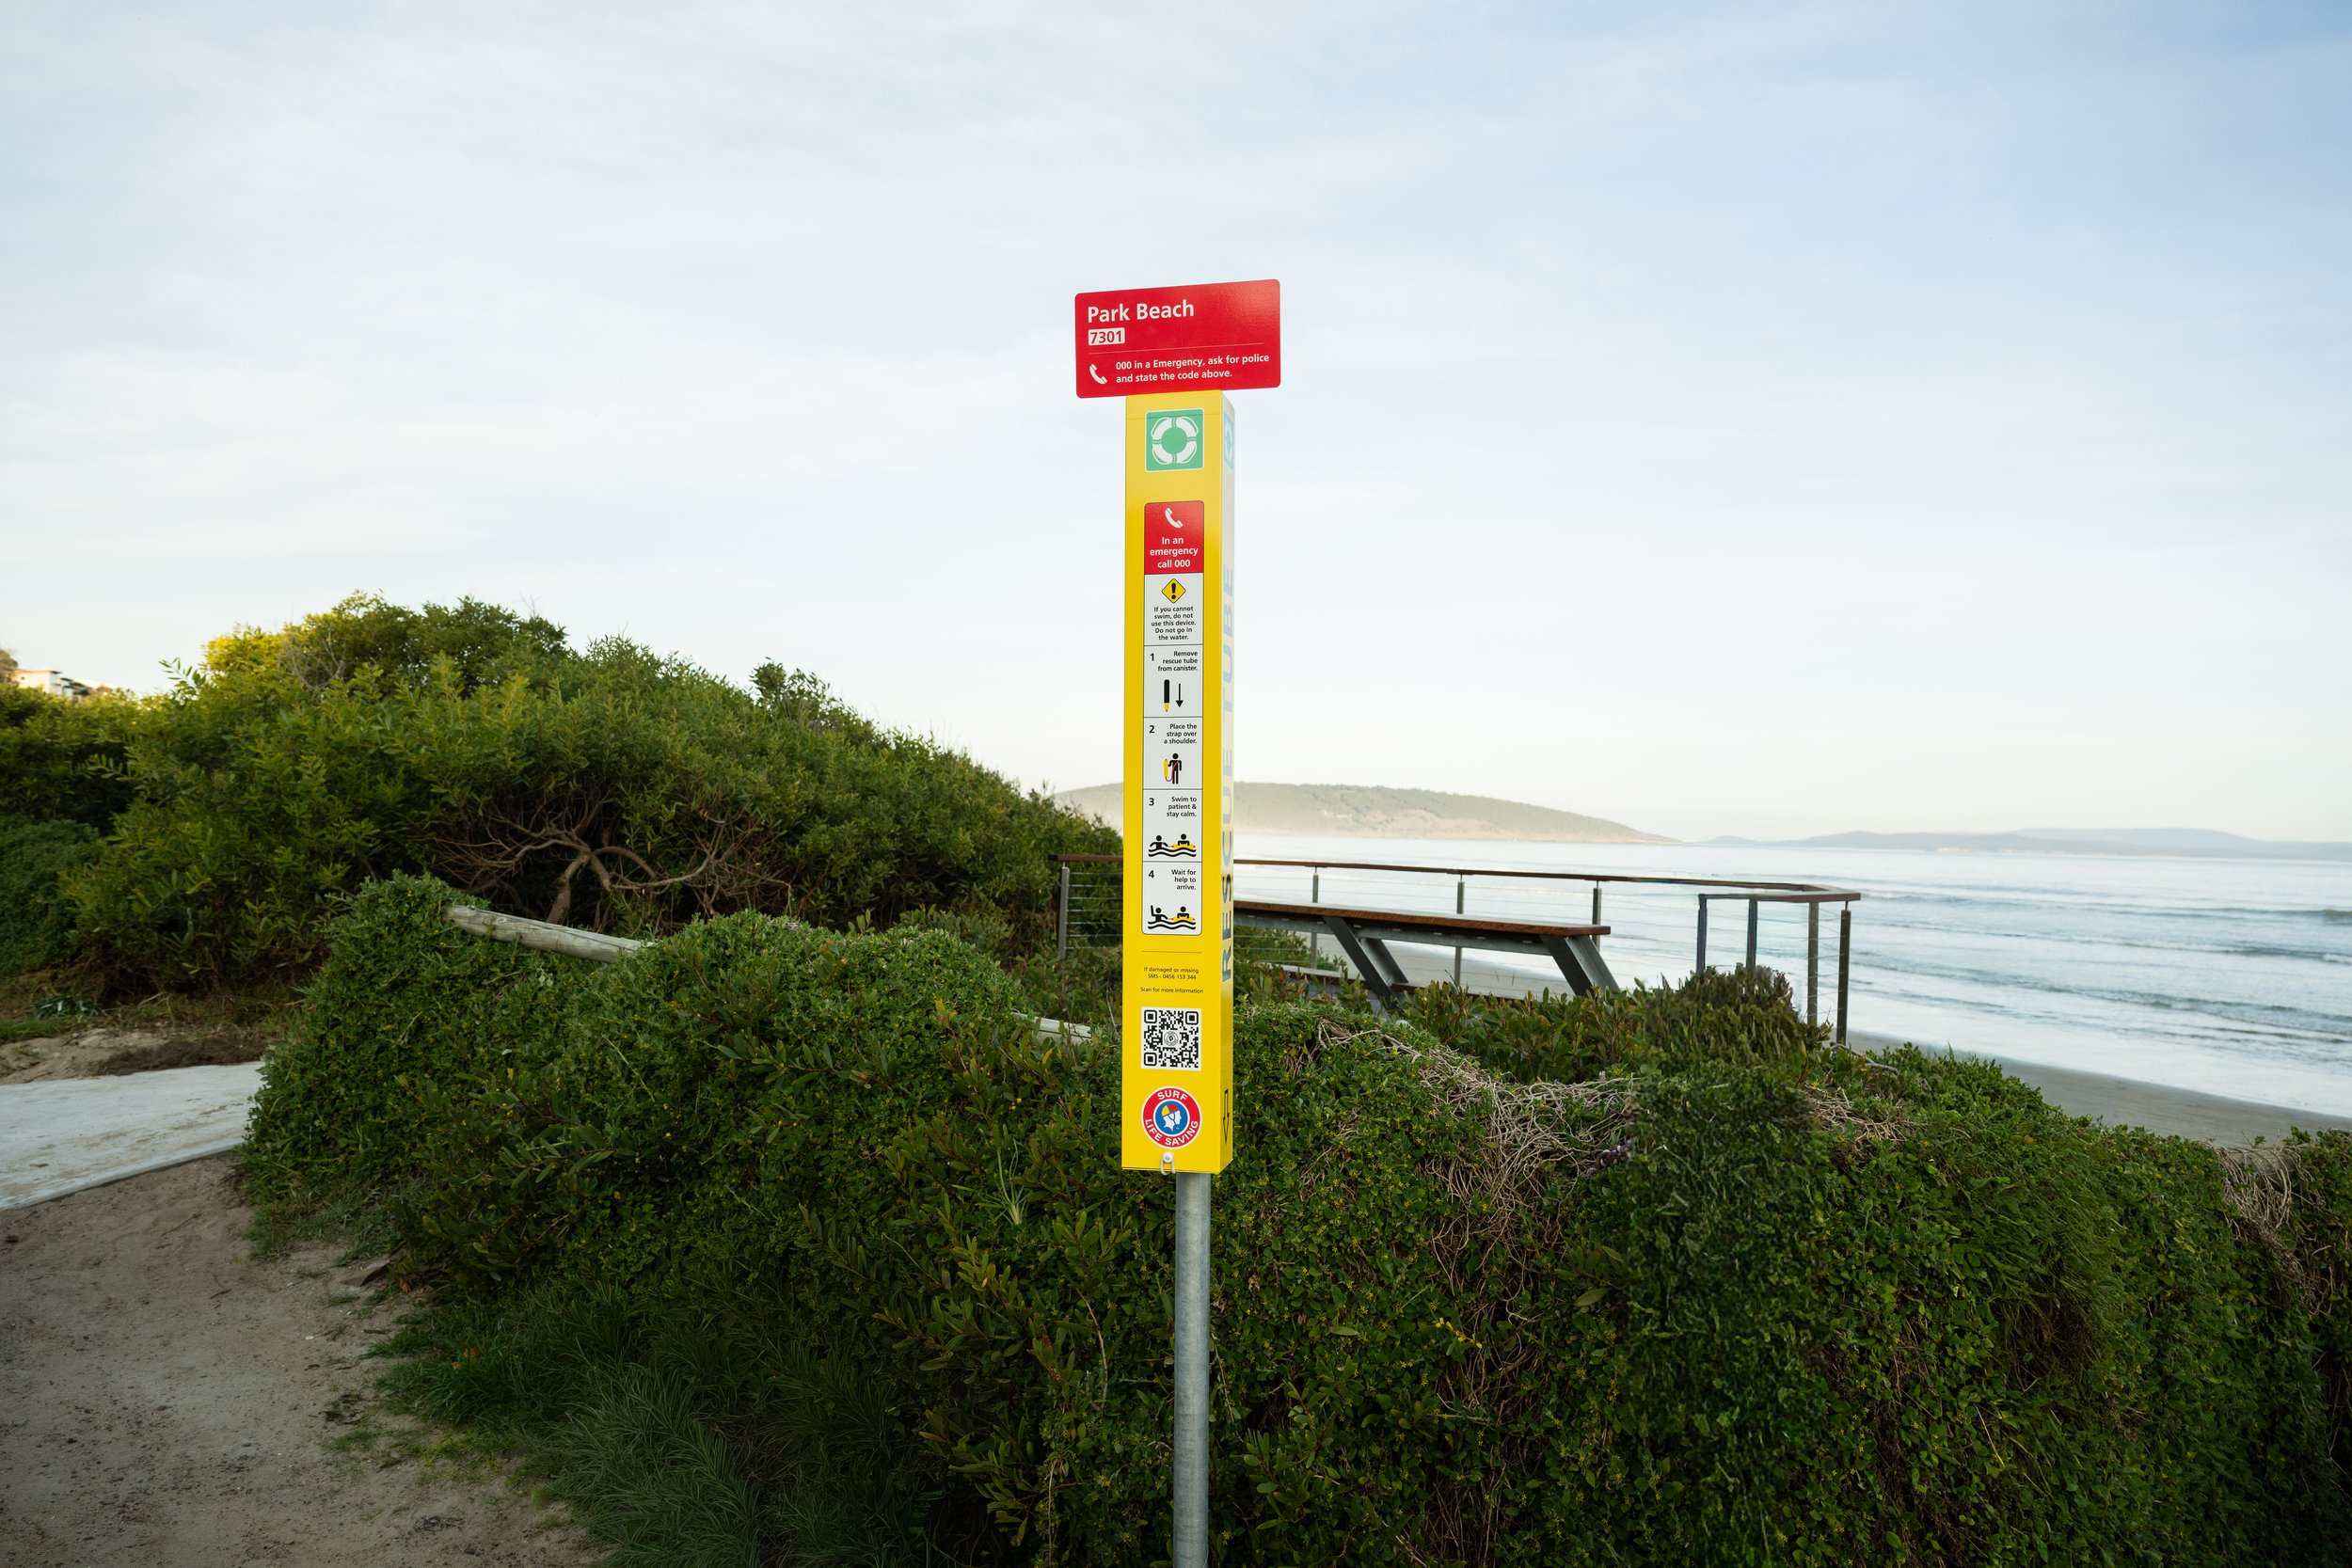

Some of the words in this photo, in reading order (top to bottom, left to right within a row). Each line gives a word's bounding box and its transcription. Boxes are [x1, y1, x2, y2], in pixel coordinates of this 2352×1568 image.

[1088, 303, 1130, 323] Park
[1136, 299, 1194, 320] Beach
[1090, 331, 1123, 343] 7301
[1116, 361, 1132, 371] 000
[1135, 360, 1142, 369] in
[1153, 358, 1205, 369] Emergency,
[1208, 356, 1223, 365] ask
[1226, 356, 1240, 364] for
[1242, 354, 1269, 366] police
[1116, 374, 1133, 383] and
[1136, 373, 1157, 382] state
[1160, 372, 1175, 380] the
[1178, 371, 1199, 380] code
[1202, 370, 1232, 378] above.
[1150, 547, 1198, 557] emergency
[1151, 653, 1154, 661] 1
[1149, 798, 1154, 806] 3
[1222, 747, 1232, 982] RESCUE
[1157, 1089, 1187, 1101] SURF
[1145, 1118, 1163, 1141] LIFE
[1165, 1120, 1199, 1146] SAVING
